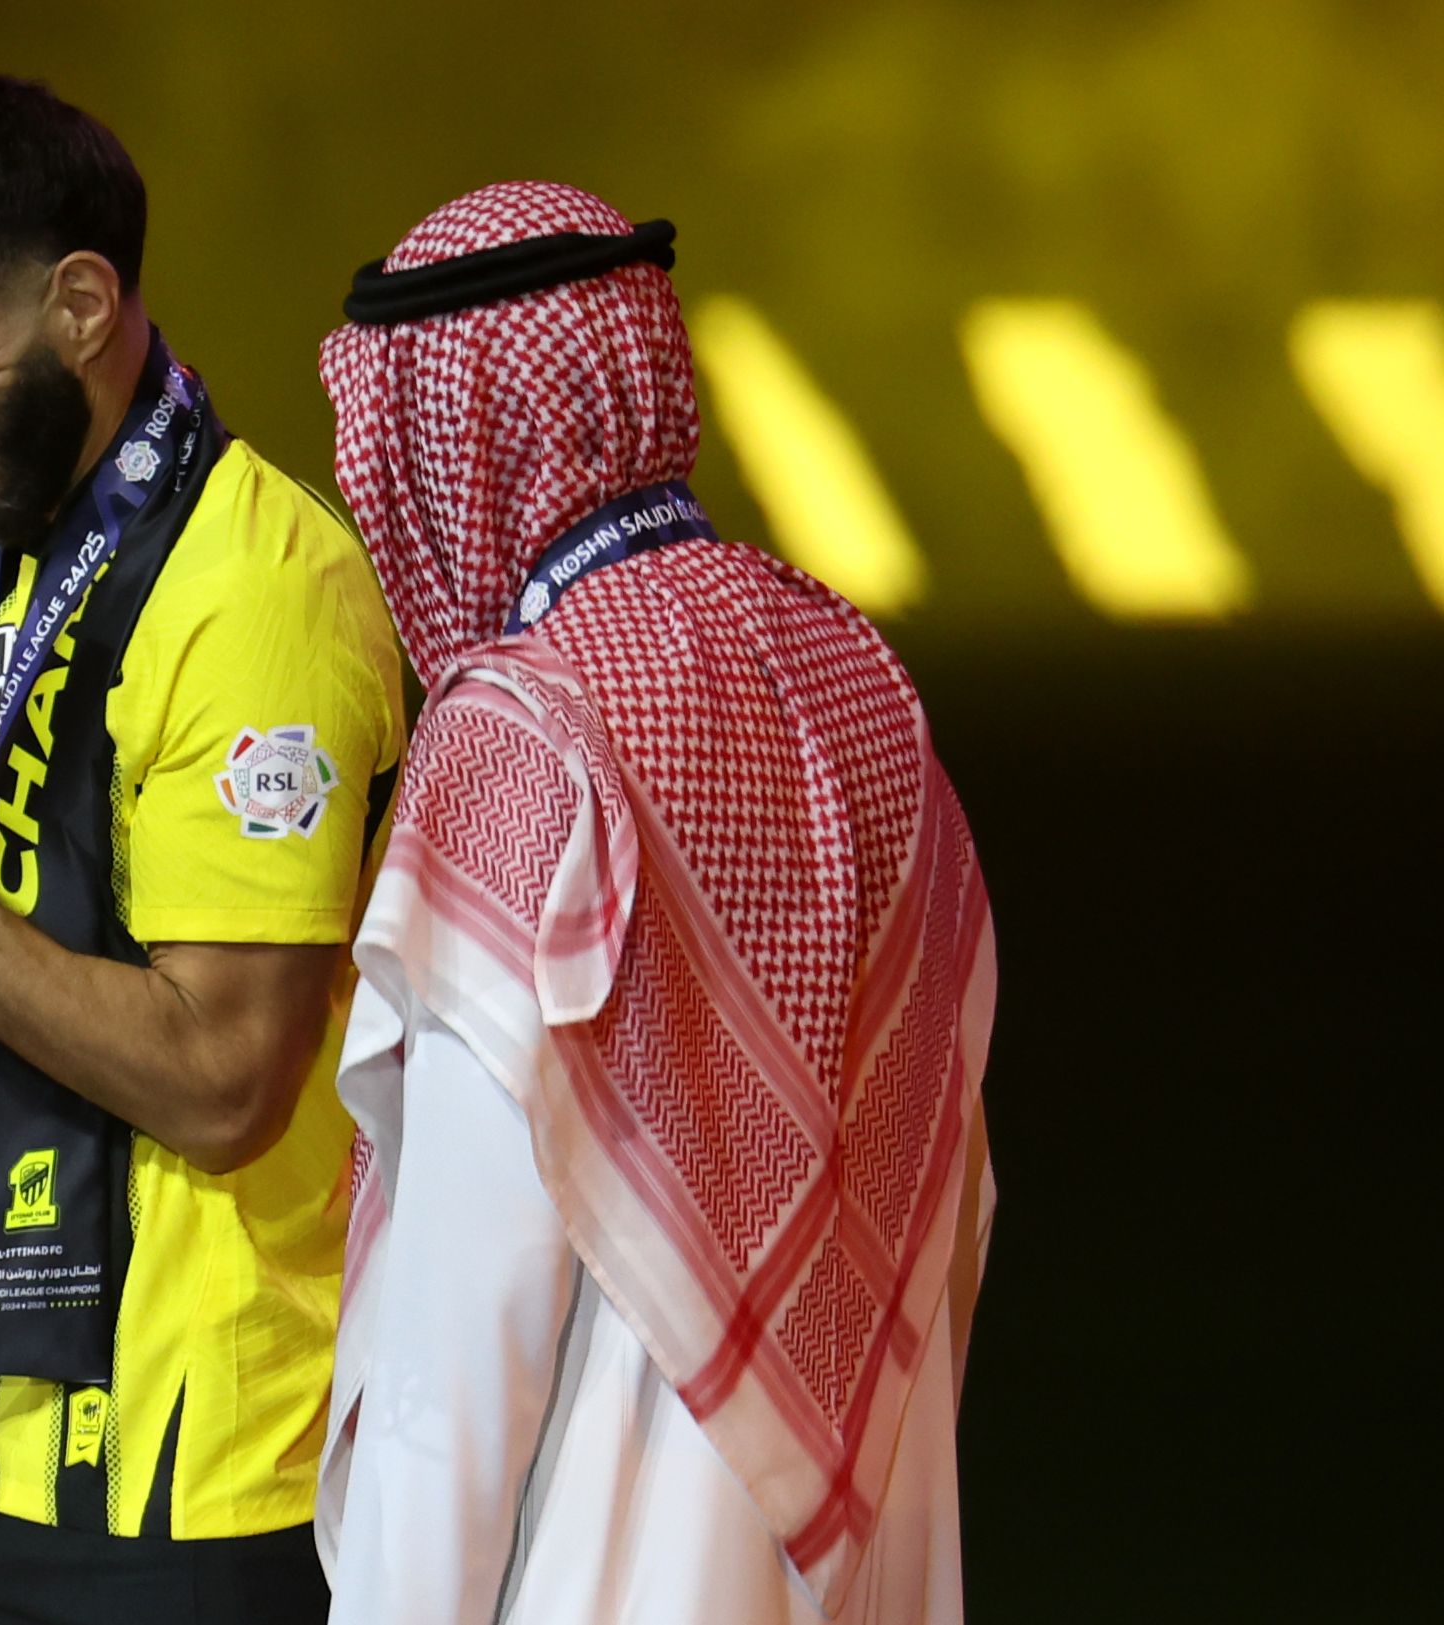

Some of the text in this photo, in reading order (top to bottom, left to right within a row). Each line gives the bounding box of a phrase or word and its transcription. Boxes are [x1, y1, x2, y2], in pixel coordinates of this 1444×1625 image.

[549, 522, 621, 588] ROSHN
[619, 502, 678, 537] SAUDI
[17, 596, 66, 673] LEAGUE
[60, 530, 106, 596] 24/25
[256, 772, 298, 792] RSL
[50, 1245, 63, 1256] FC
[6, 1267, 37, 1281] روشن
[38, 1268, 68, 1280] دوري
[9, 1287, 44, 1298] LEAGUE
[45, 1284, 101, 1296] CHAMPIONS
